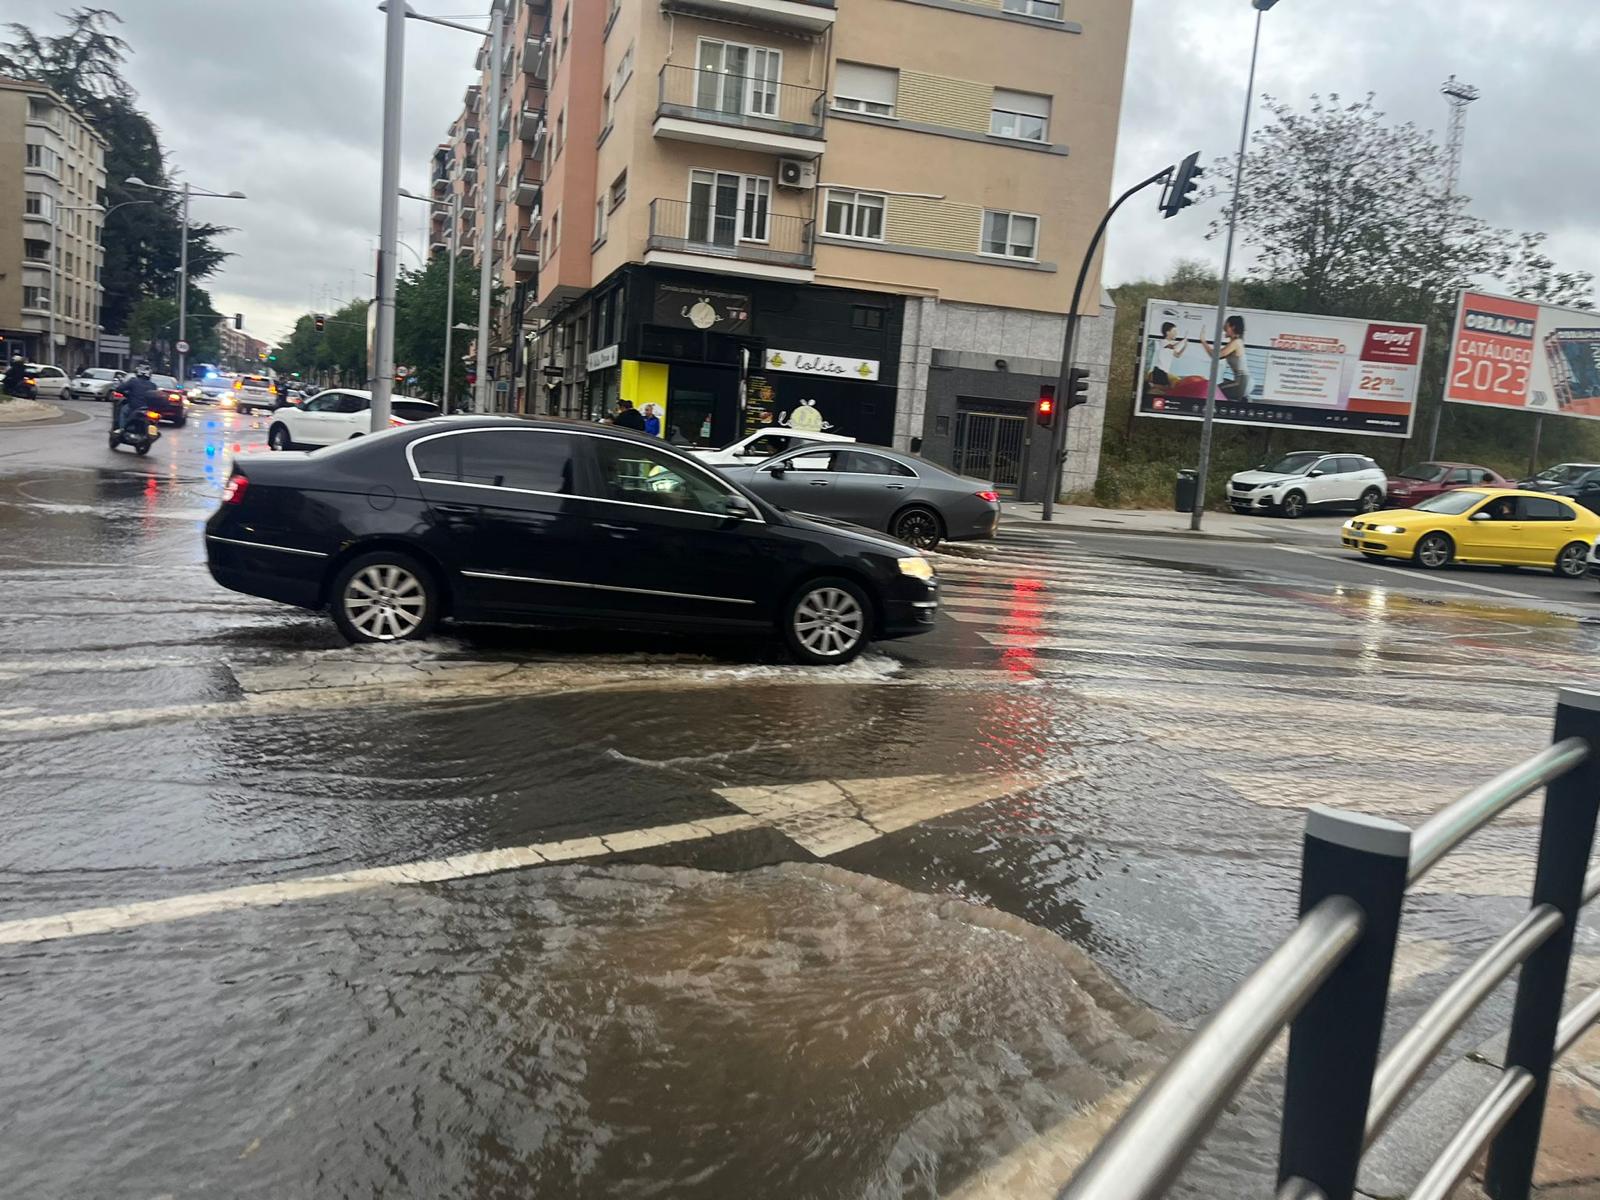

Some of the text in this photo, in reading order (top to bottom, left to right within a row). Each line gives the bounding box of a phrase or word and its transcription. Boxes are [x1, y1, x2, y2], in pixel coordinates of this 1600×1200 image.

[1465, 314, 1534, 336] OBRAMAT
[1372, 330, 1415, 346] enjoy!
[1458, 340, 1532, 363] CATÁLOGO
[795, 355, 846, 373] lolito
[1453, 358, 1530, 395] 2023
